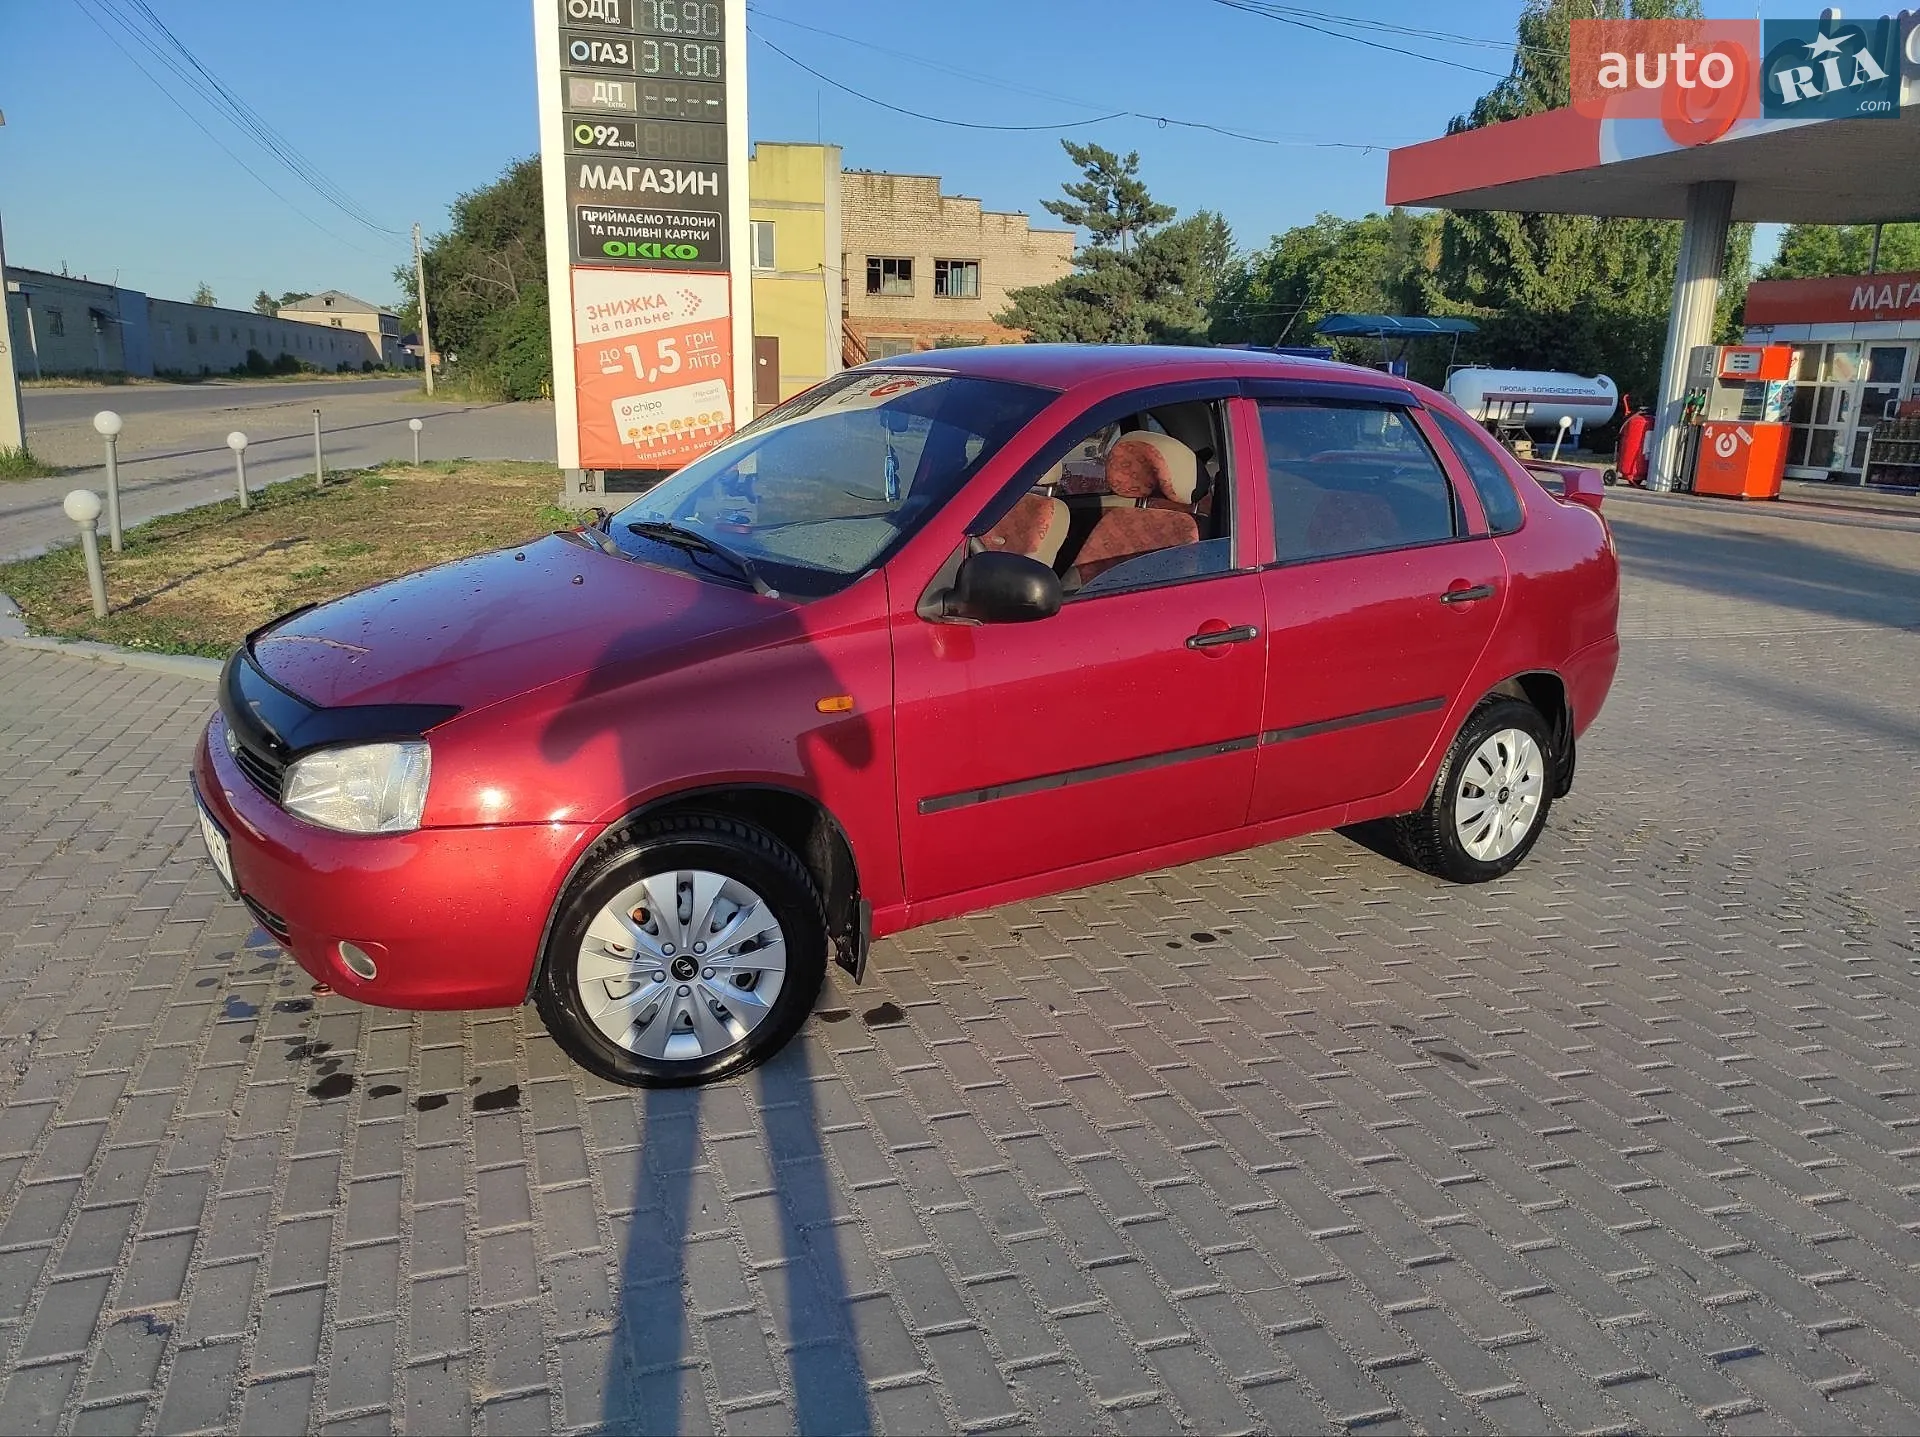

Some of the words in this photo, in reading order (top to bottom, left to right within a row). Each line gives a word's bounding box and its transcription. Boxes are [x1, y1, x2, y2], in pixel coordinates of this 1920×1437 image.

[605, 17, 621, 25] EURO
[579, 164, 718, 196] МАГАЗИН
[582, 210, 663, 225] ПРИЙМАЄМО
[666, 215, 716, 228] ТАЛОНИ
[589, 225, 604, 236] ТА
[607, 226, 662, 239] ПАЛИВНІ
[665, 229, 710, 241] КАРТКИ
[586, 293, 668, 321] ЗНИЖКА
[591, 323, 610, 334] на
[615, 312, 671, 331] пальне
[685, 330, 715, 350] грн
[600, 348, 621, 366] до
[687, 353, 722, 370] літр
[1499, 385, 1526, 393] ПРОПАН
[1704, 426, 1713, 438] 4
